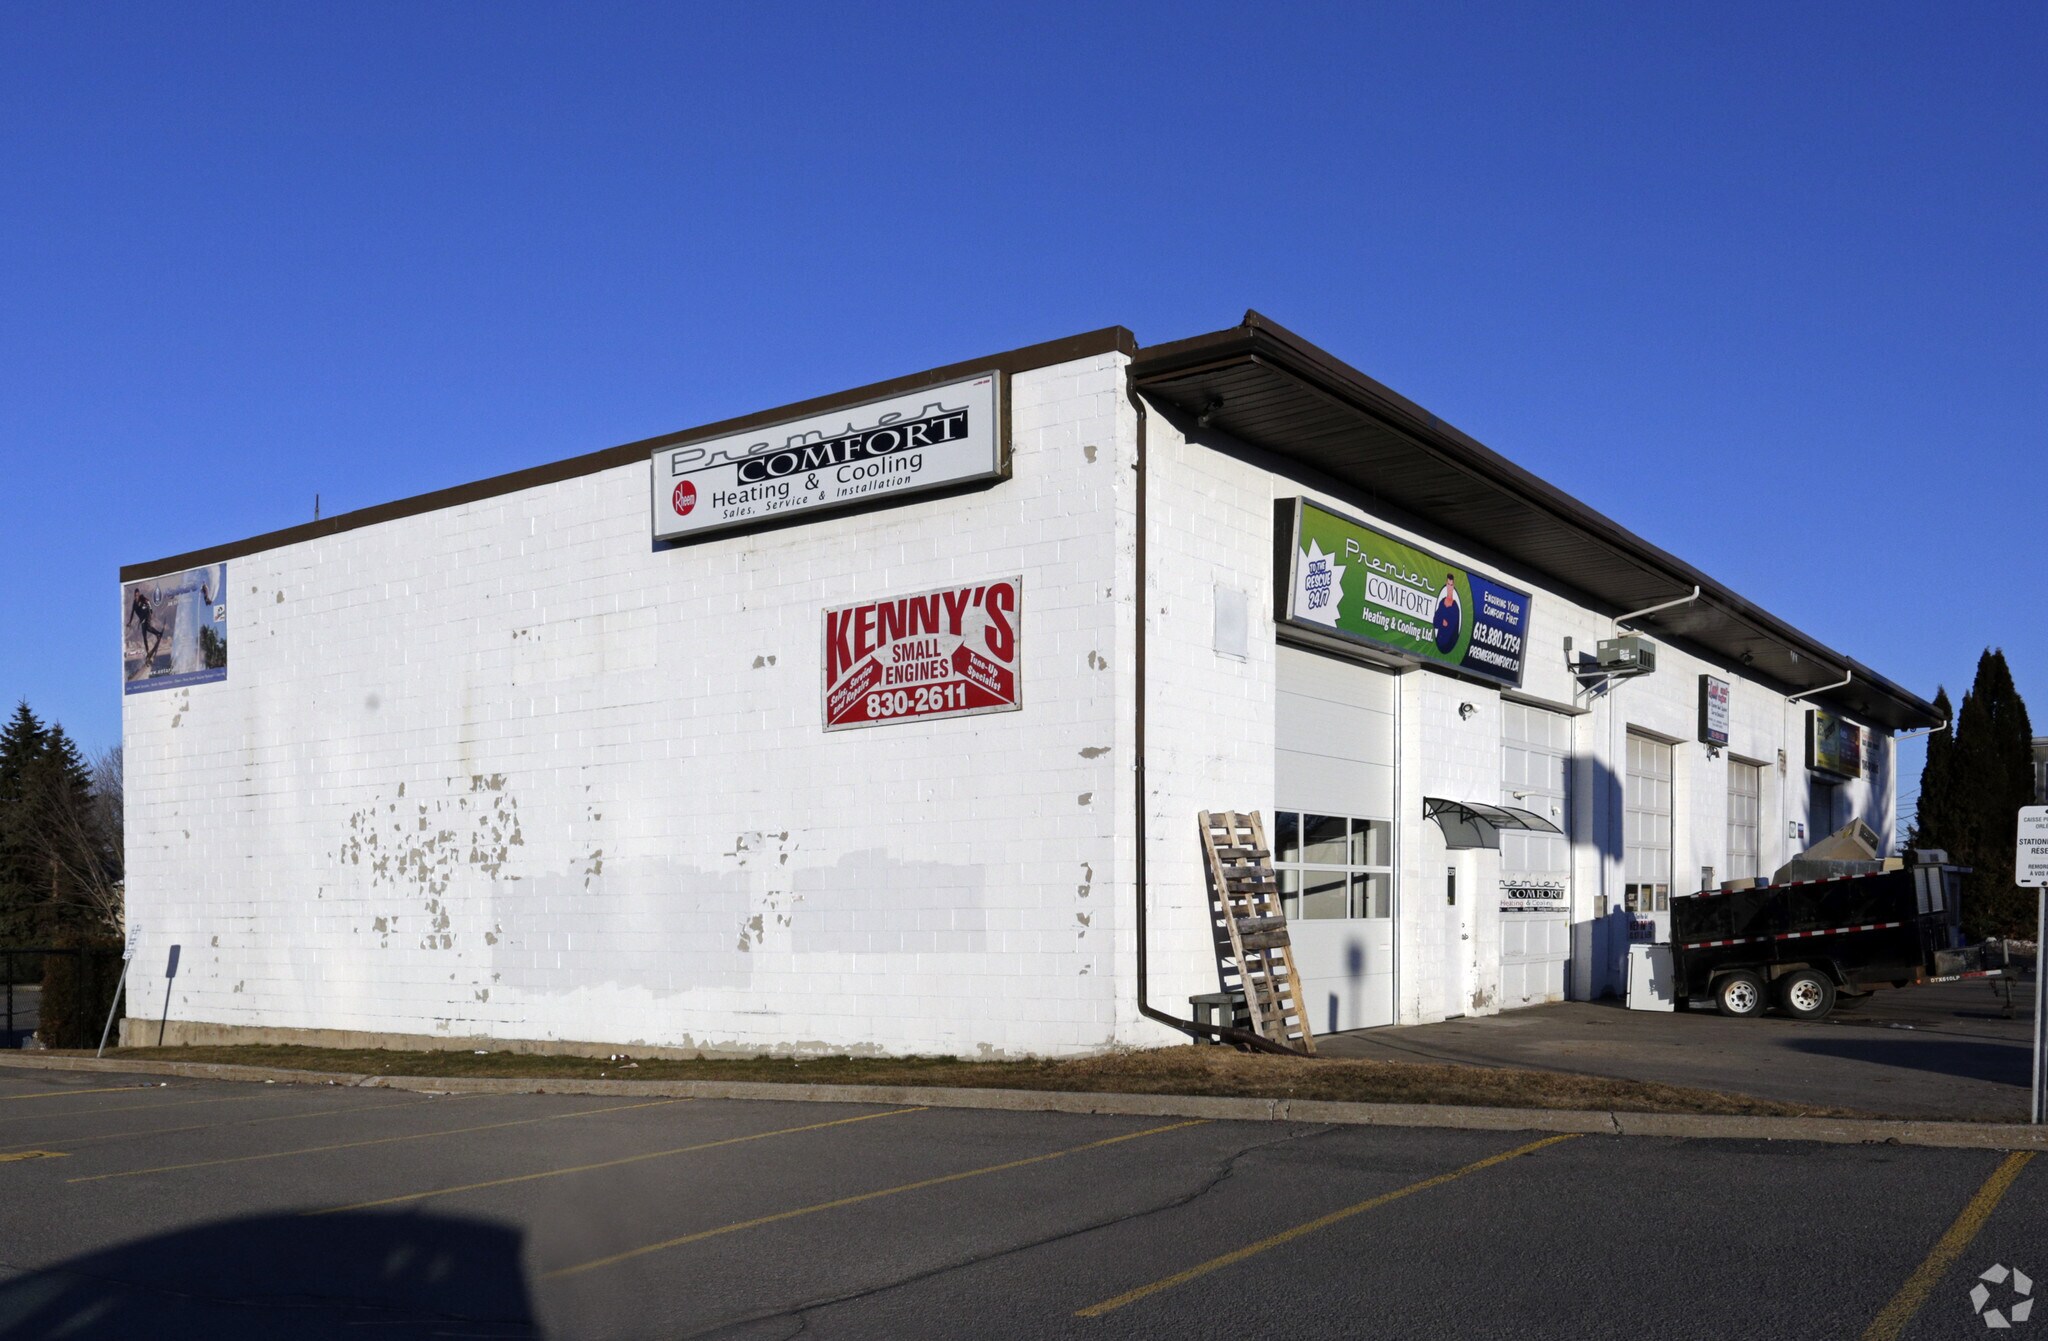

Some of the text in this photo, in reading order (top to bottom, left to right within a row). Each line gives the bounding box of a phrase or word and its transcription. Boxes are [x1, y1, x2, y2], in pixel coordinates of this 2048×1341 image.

[672, 402, 970, 473] Premier
[738, 412, 964, 483] COMFORT
[713, 454, 923, 508] Heating & Cooling
[766, 495, 808, 511] Service
[819, 491, 825, 500] &
[837, 475, 911, 497] Installation
[1305, 570, 1332, 591] RESCUE
[1345, 538, 1435, 592] Premier
[1308, 588, 1330, 610] 24/7
[1368, 578, 1432, 616] COMFORT
[827, 582, 1014, 693] KENNY'S
[1362, 607, 1434, 642] Heating & Cooling Ltd.
[1473, 621, 1521, 655] 613.880.2754
[892, 638, 941, 664] SMALL
[970, 652, 998, 679] Tune-Up
[1468, 645, 1520, 672] PREMIERCOMFORT.CA
[850, 665, 873, 689] Service
[885, 658, 949, 686] ENGINES
[967, 665, 1001, 691] Specialist
[867, 683, 966, 718] 830-2611
[1499, 878, 1566, 888] remier
[1508, 889, 1564, 899] COMFORT
